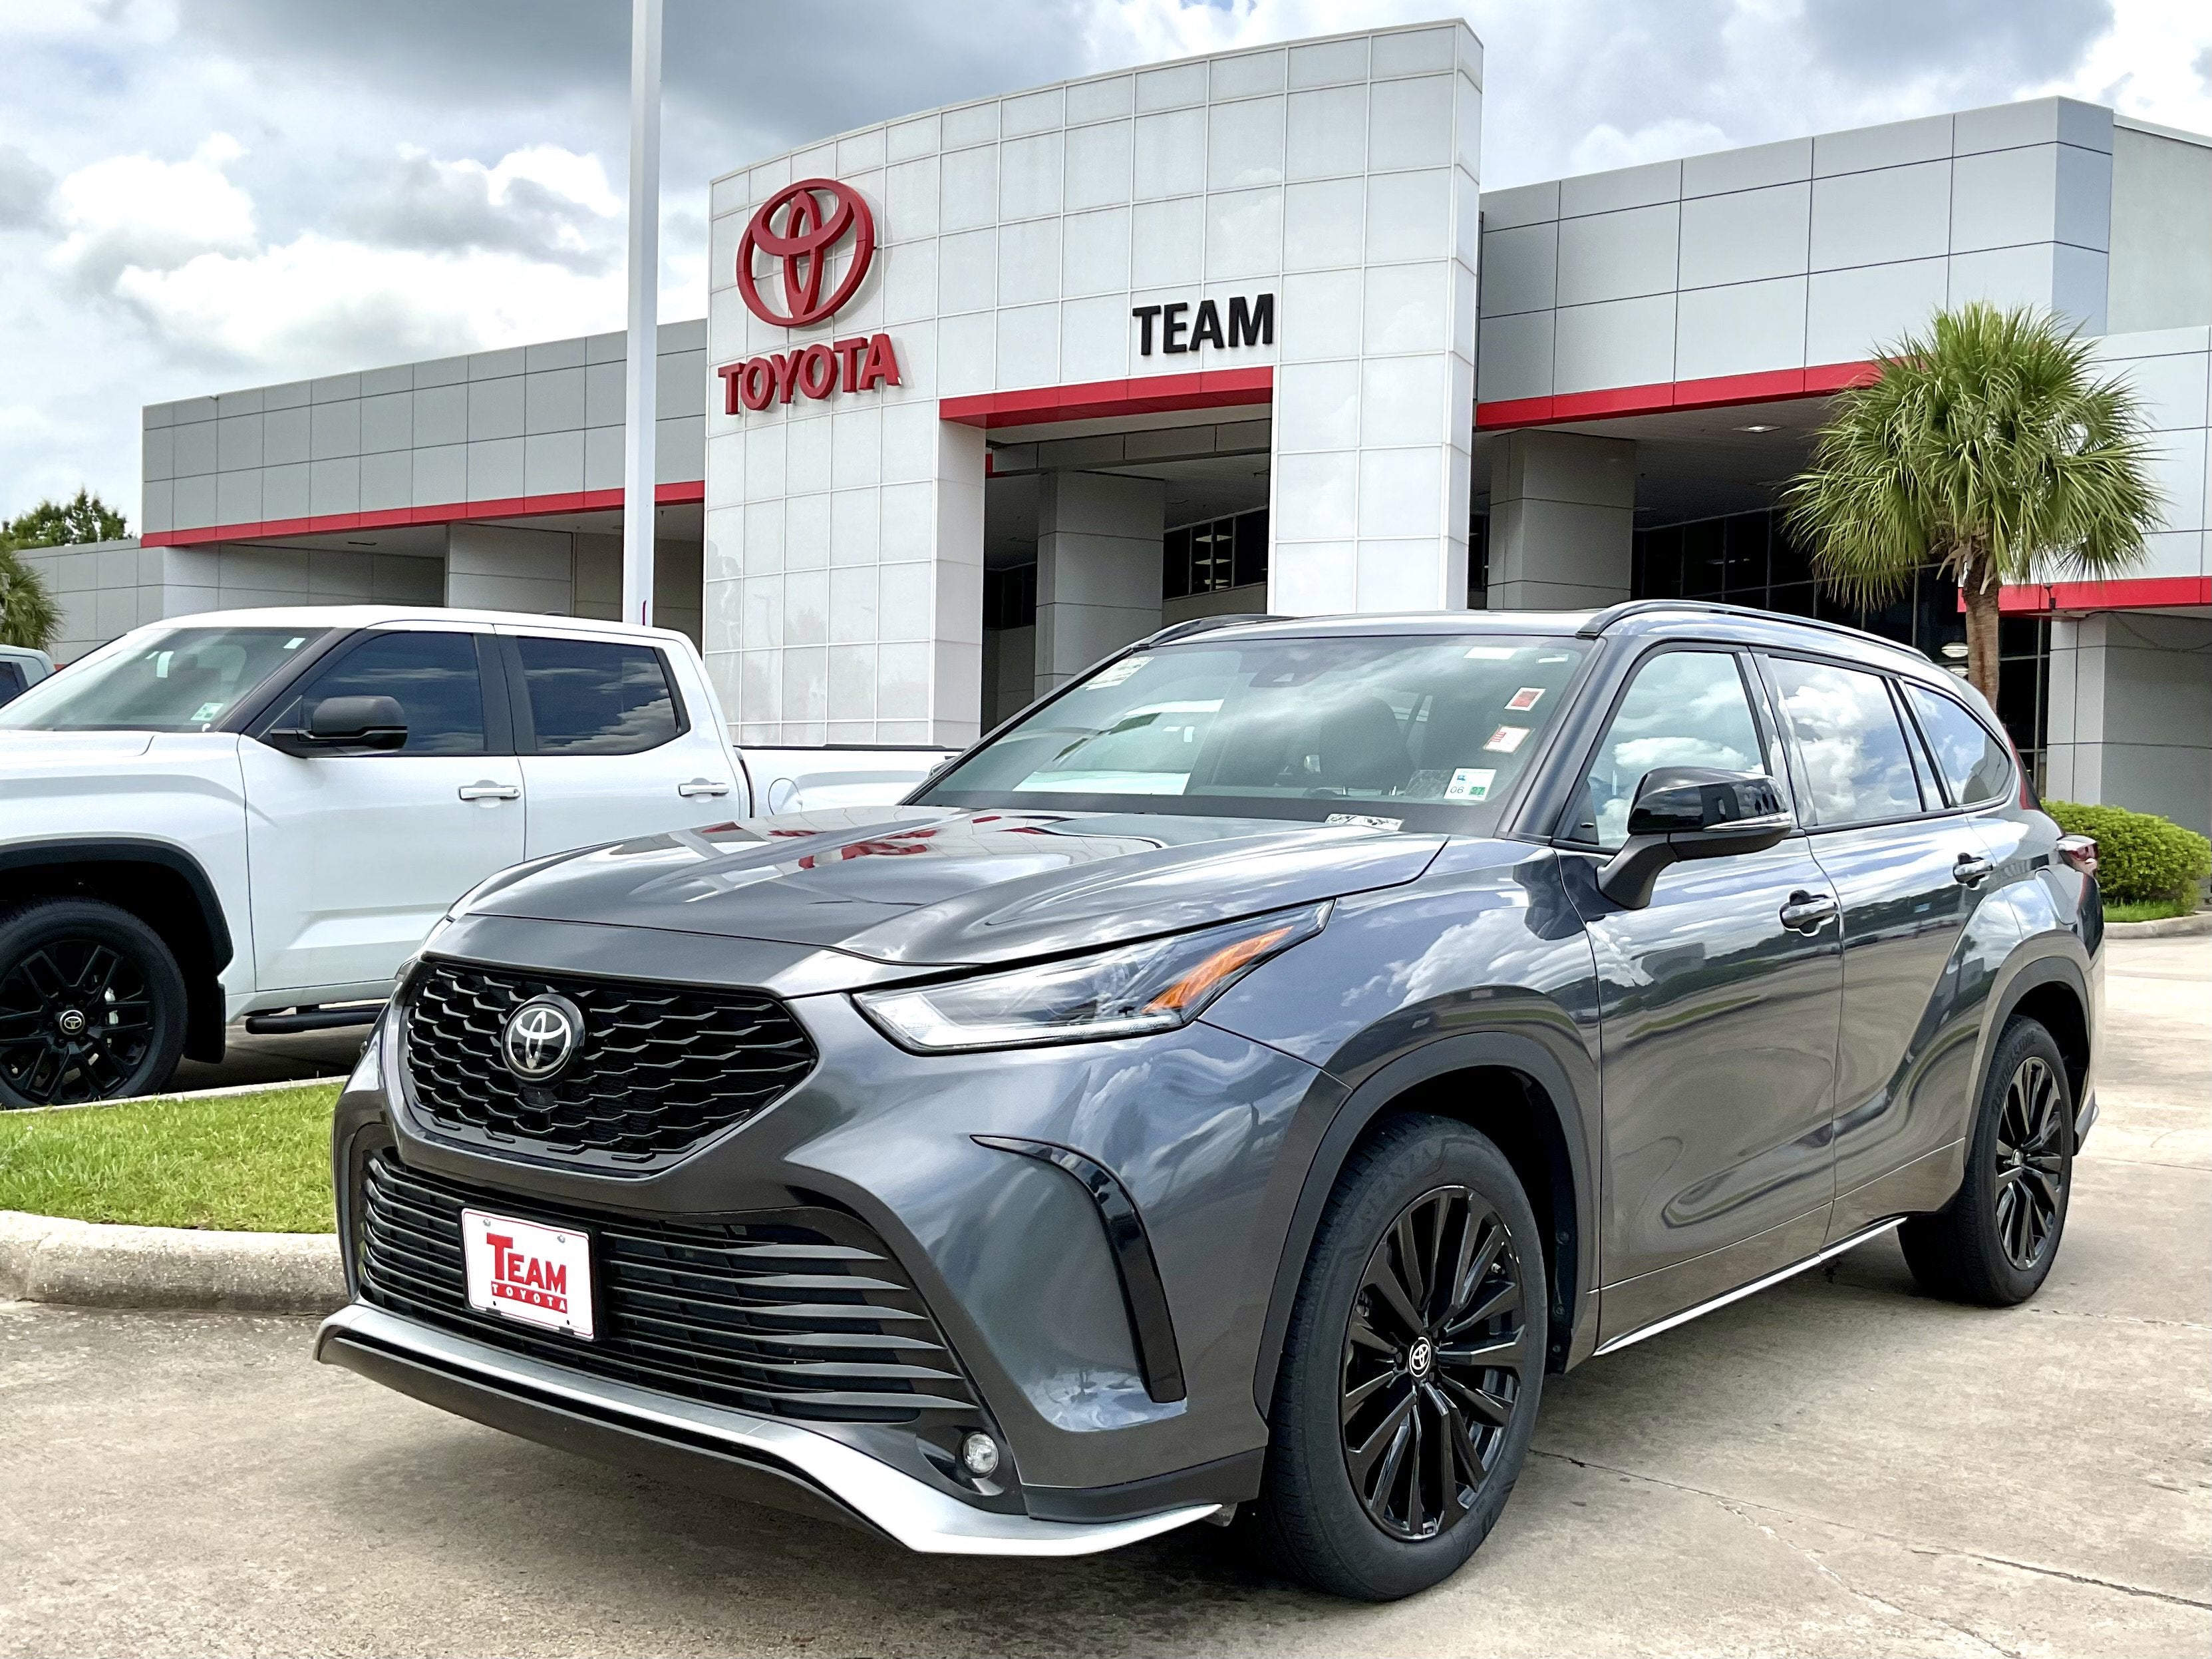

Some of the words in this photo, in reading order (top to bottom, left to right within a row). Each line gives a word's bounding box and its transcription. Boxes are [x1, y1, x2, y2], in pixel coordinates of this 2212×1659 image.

[1132, 293, 1273, 355] TEAM
[718, 333, 901, 415] TOYOTA
[486, 1232, 566, 1295] TEAM
[492, 1283, 566, 1311] TOYOTA
